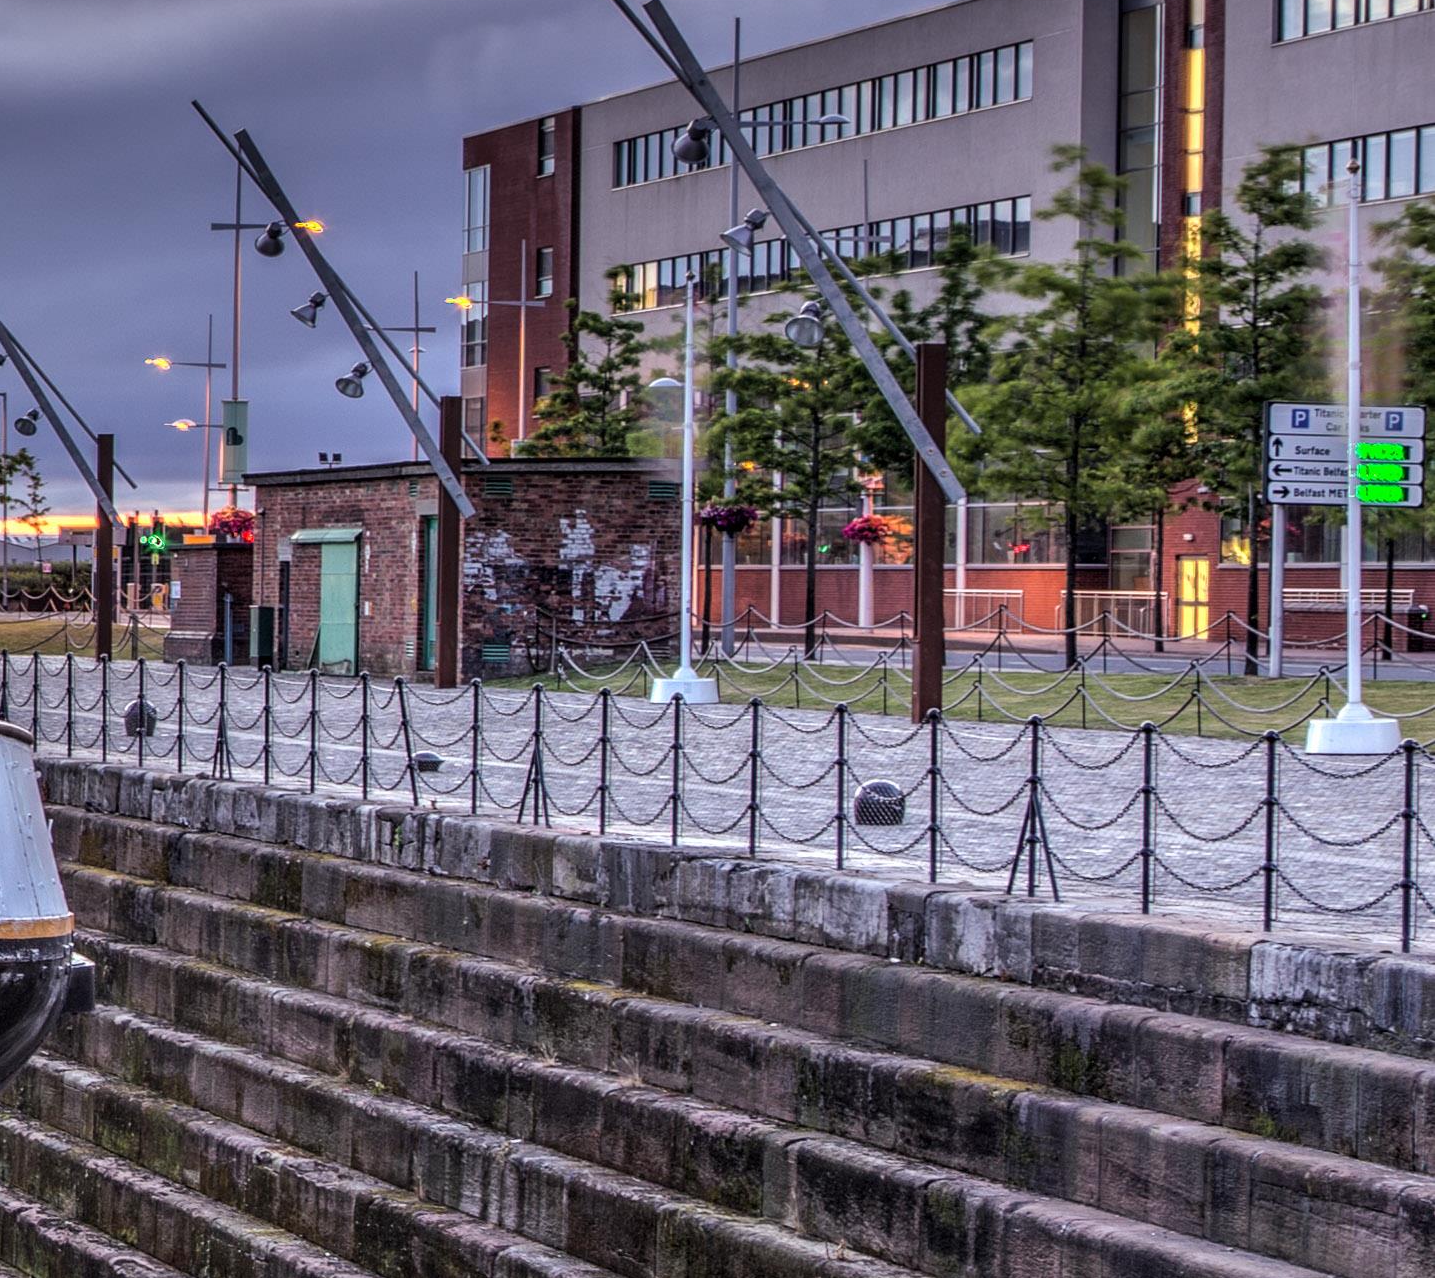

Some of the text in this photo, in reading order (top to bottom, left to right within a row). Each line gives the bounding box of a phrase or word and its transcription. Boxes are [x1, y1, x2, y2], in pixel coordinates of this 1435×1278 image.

[1315, 408, 1344, 418] Titanic
[1294, 446, 1330, 455] Surface
[1294, 466, 1321, 476] Titanic
[1294, 488, 1325, 498] Belfast
